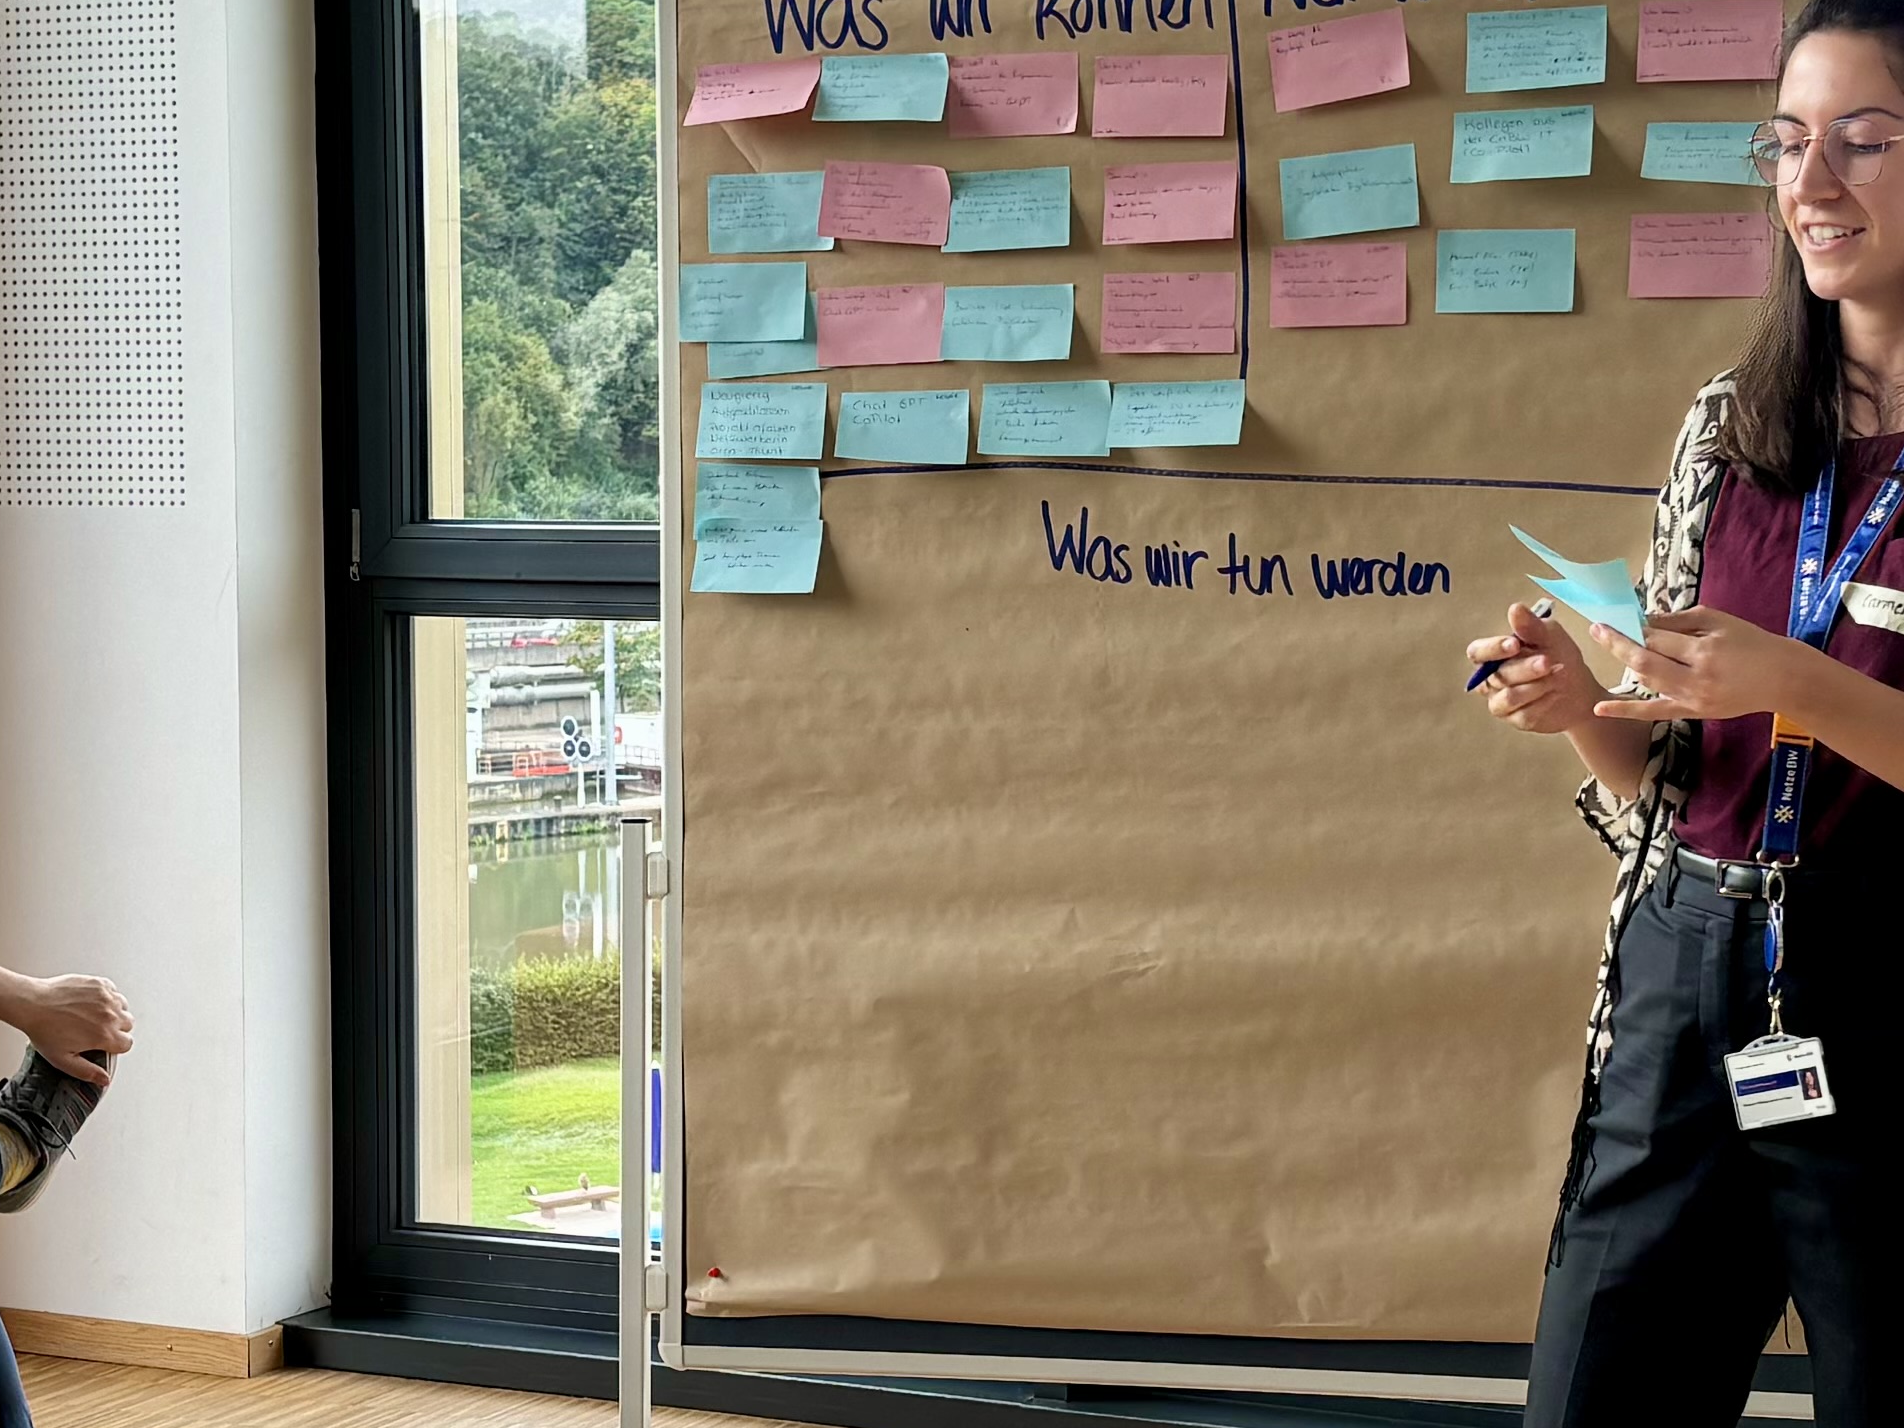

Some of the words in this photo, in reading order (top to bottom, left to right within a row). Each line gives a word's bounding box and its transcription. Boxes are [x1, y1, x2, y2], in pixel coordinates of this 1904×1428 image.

[1041, 500, 1132, 585] Was
[1145, 540, 1208, 590] wir
[1216, 532, 1294, 595] tun
[1311, 552, 1451, 600] werden
